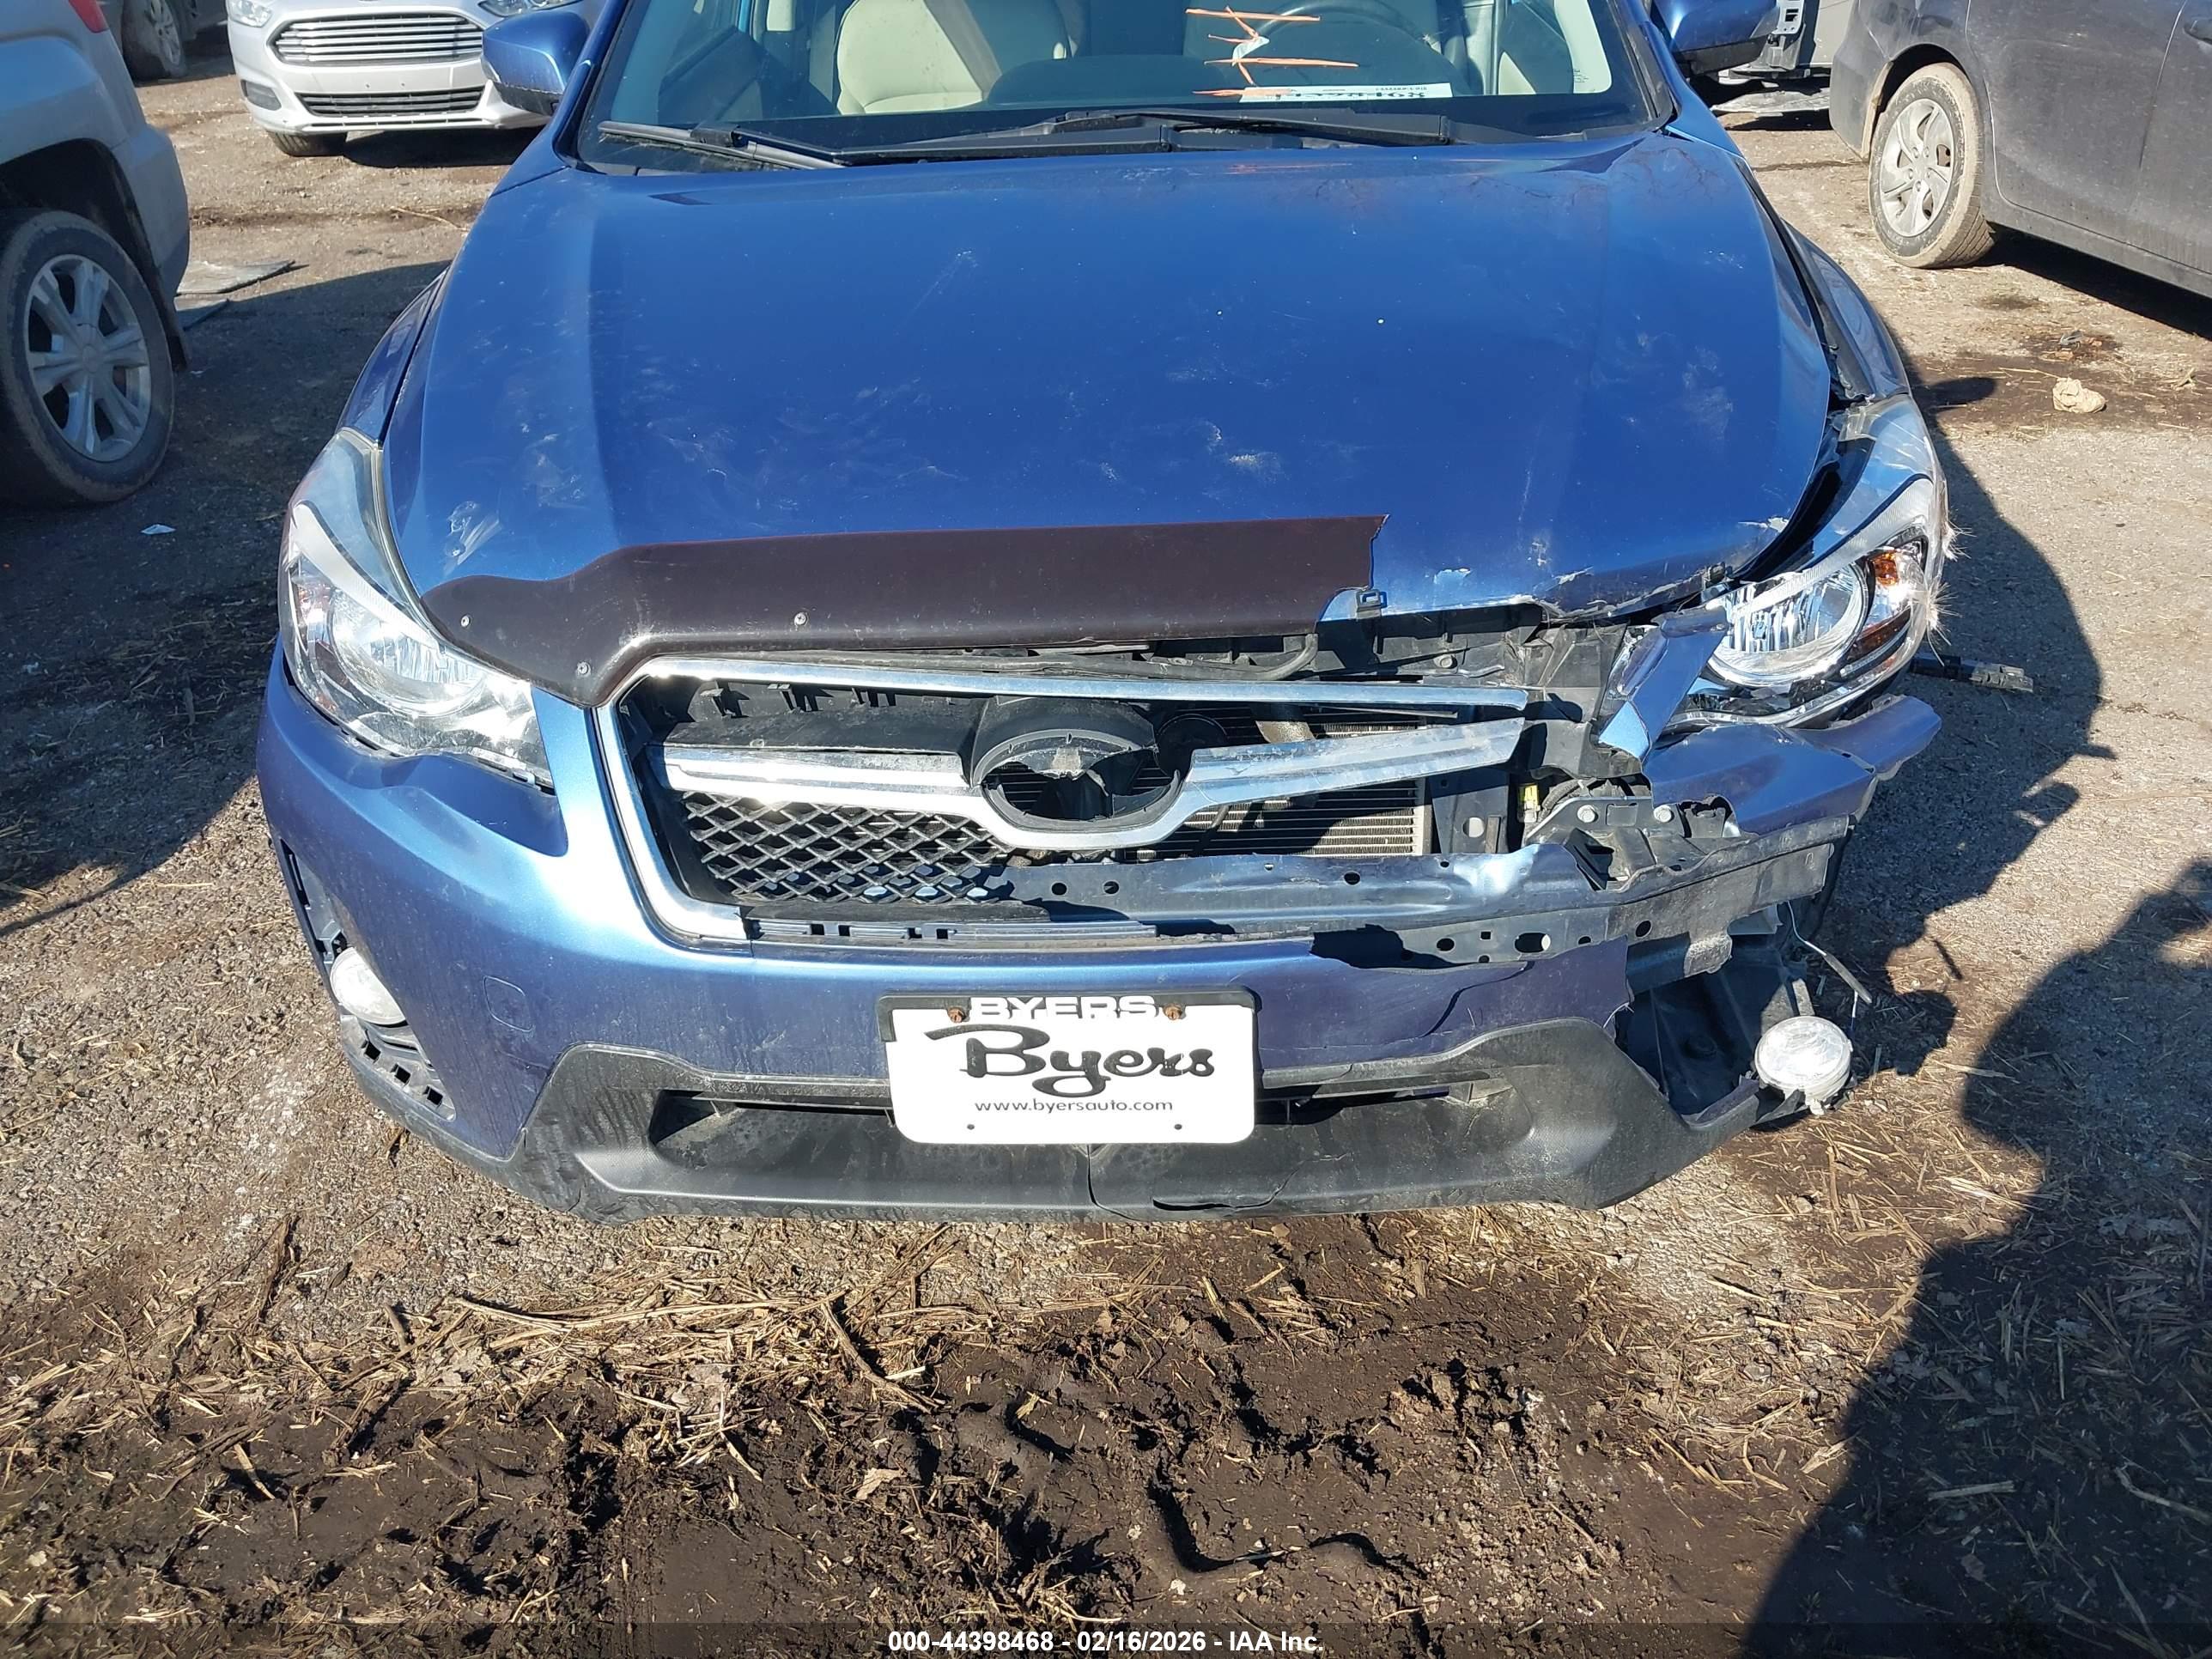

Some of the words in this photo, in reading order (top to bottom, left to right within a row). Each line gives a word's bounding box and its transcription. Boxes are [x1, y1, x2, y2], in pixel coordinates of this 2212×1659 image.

[970, 996, 1159, 1019] BYERS
[924, 1024, 1214, 1097] Byers
[975, 1099, 1173, 1115] www.byersauto.com
